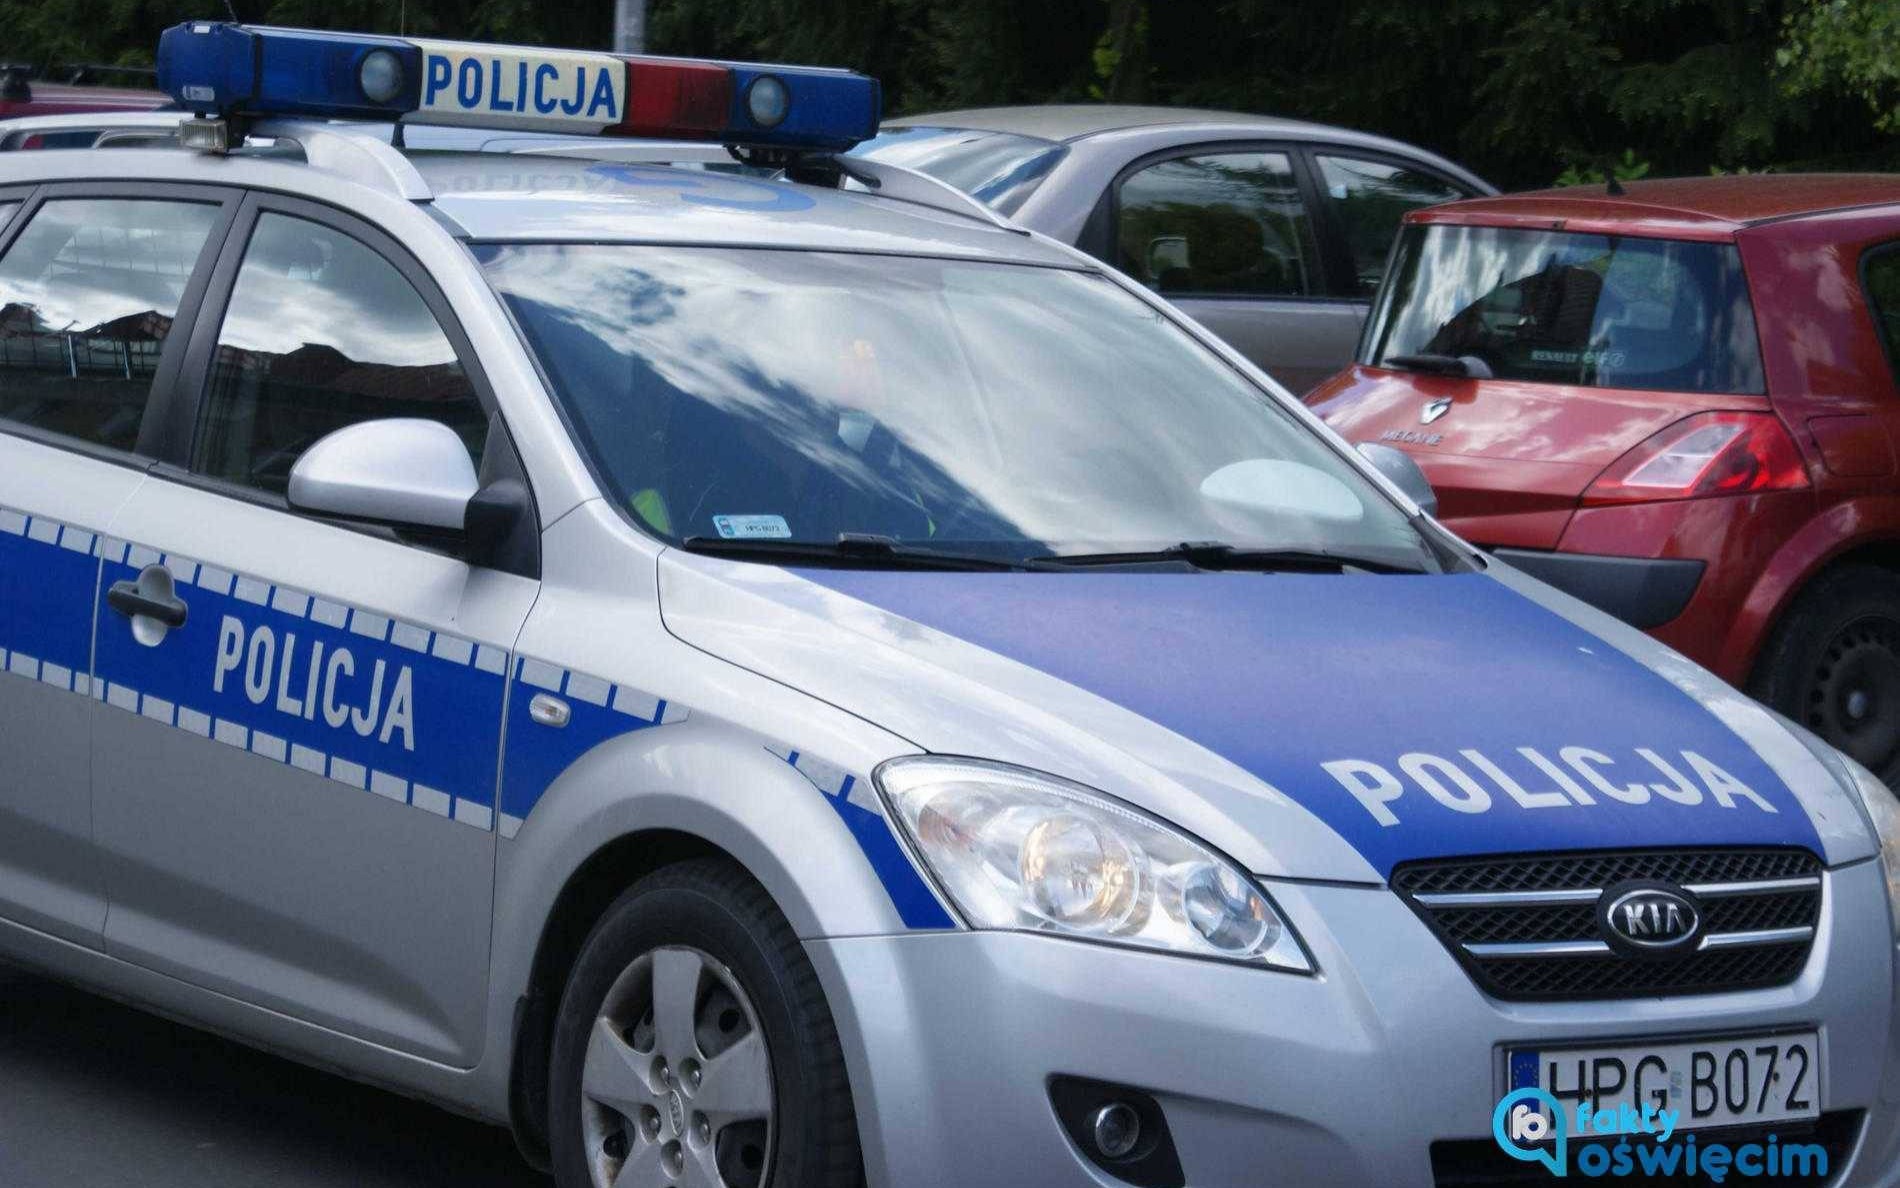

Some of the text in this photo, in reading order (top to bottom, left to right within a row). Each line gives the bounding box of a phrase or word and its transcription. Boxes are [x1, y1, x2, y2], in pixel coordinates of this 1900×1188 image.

[426, 54, 618, 119] POLICJA
[213, 614, 415, 752] POLICJA
[1320, 745, 1779, 828] POLICJA
[1623, 902, 1688, 936] KIA
[1549, 1043, 1810, 1131] HPG B072
